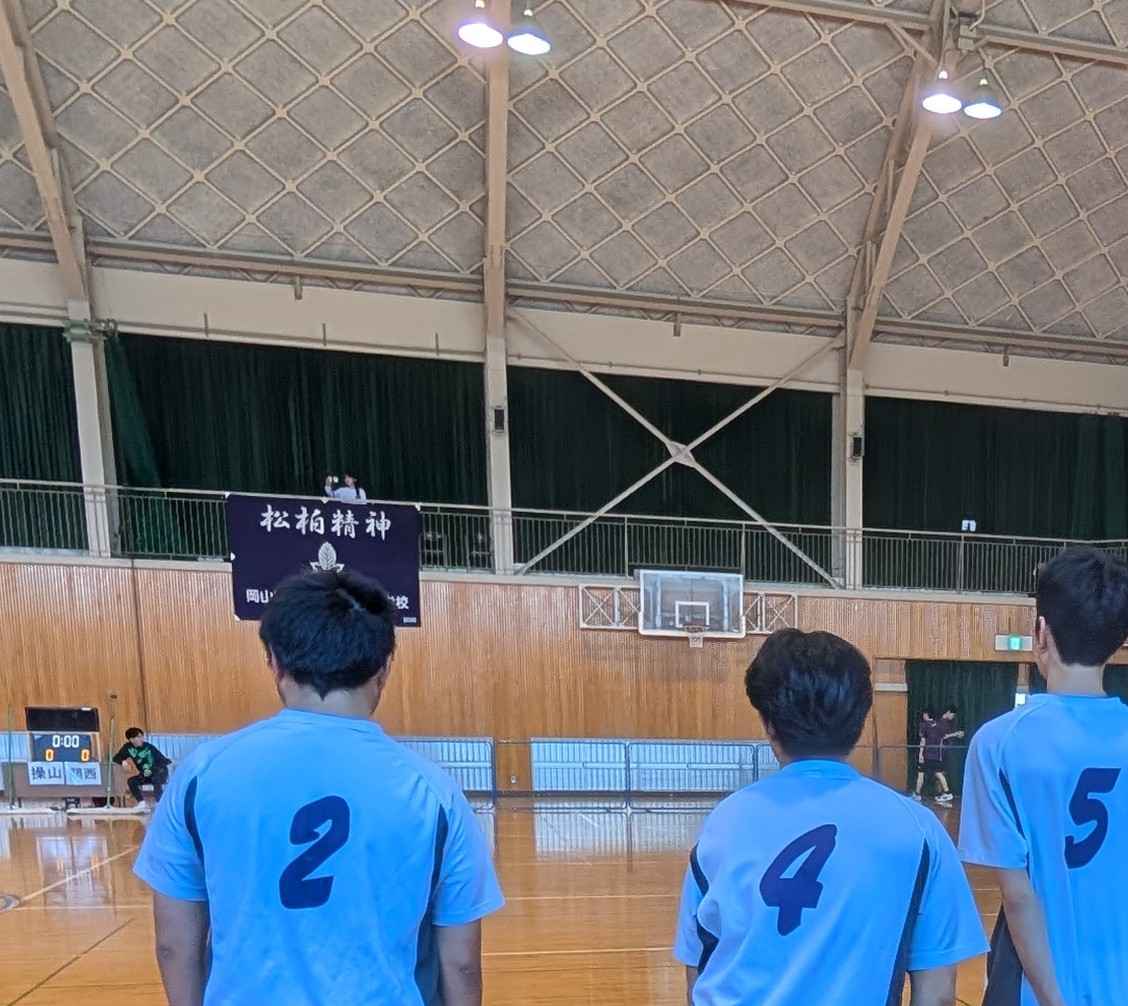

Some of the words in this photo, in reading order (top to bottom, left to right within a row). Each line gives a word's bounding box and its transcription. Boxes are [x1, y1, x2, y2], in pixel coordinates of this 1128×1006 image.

[259, 504, 392, 541] 松柏精神
[52, 734, 80, 748] 0:00
[45, 749, 54, 762] 0
[81, 749, 90, 762] 0
[31, 766, 62, 780] 操山
[1064, 768, 1121, 869] 5
[279, 796, 350, 909] 2
[760, 824, 837, 936] 4
